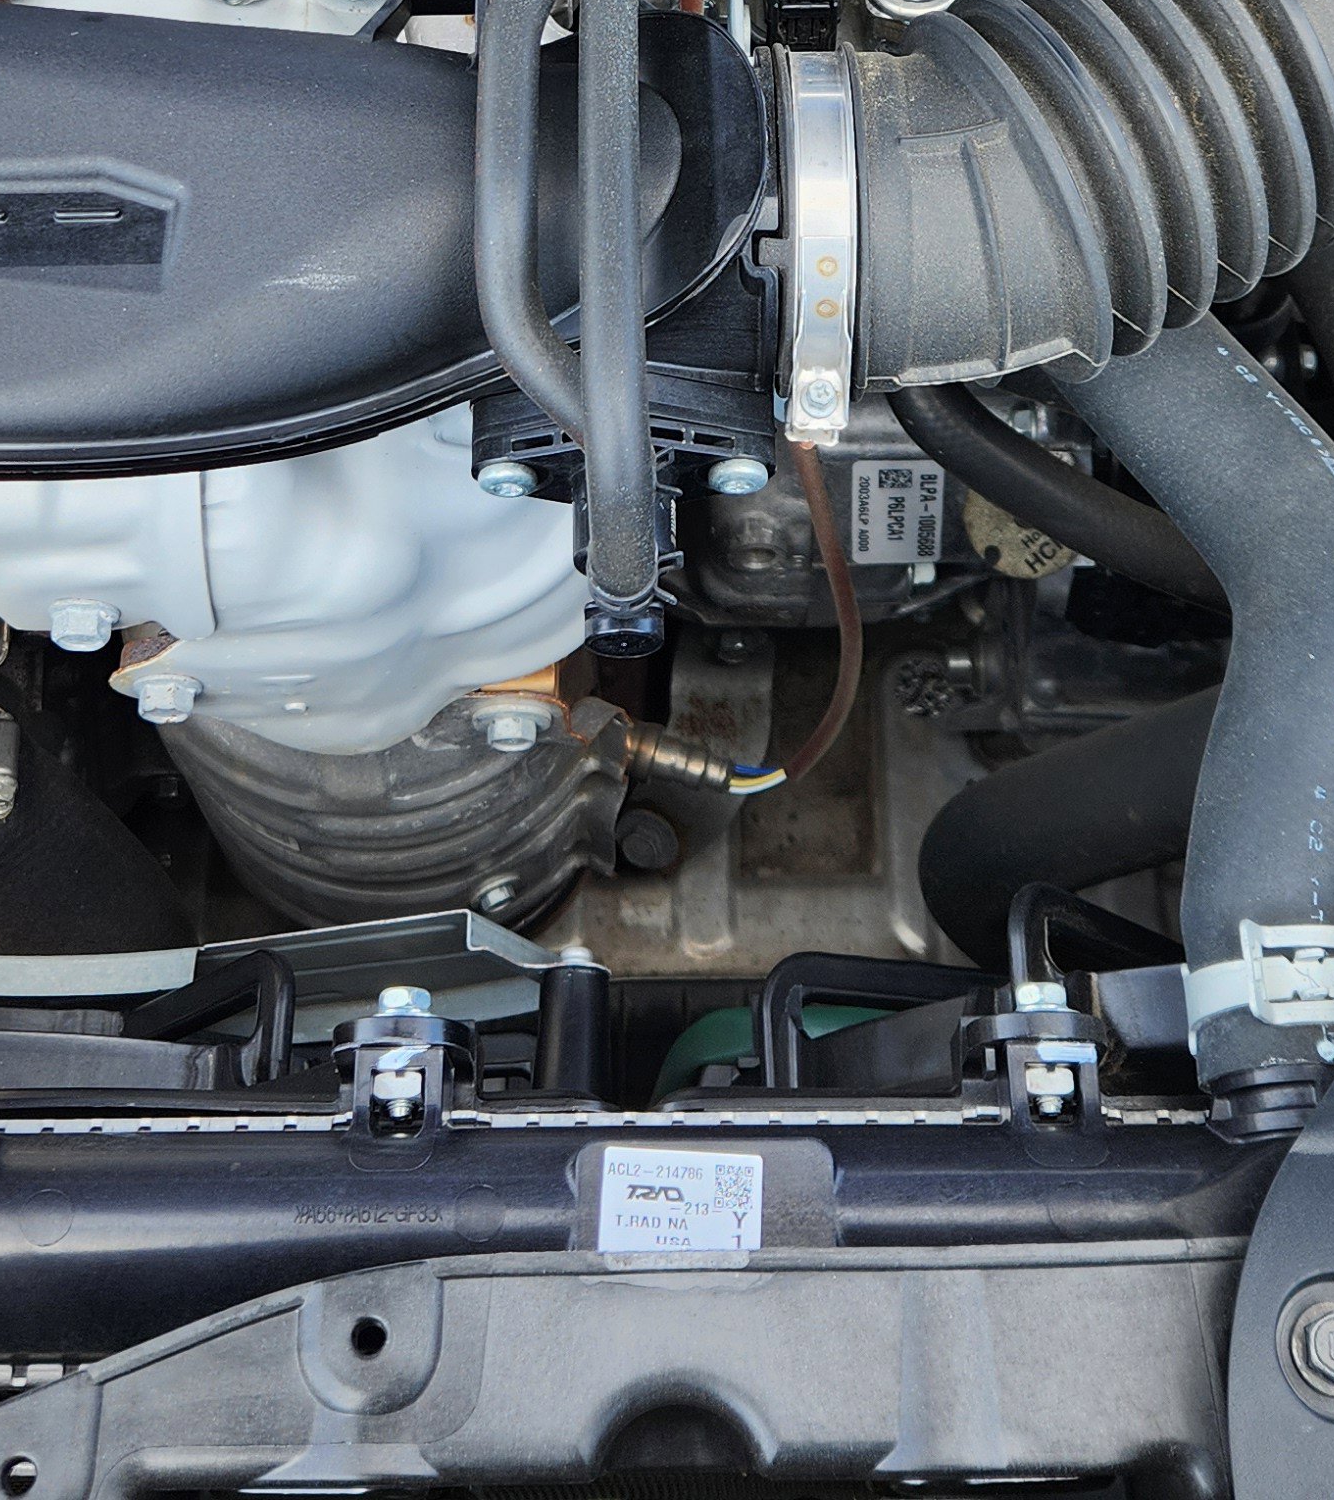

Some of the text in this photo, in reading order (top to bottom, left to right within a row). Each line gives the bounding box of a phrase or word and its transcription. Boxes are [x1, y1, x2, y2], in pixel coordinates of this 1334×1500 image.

[887, 496, 906, 541] P6LPCA1
[607, 1162, 704, 1181] ACL2-214786
[668, 1216, 689, 1231] NA
[732, 1211, 748, 1230] Y
